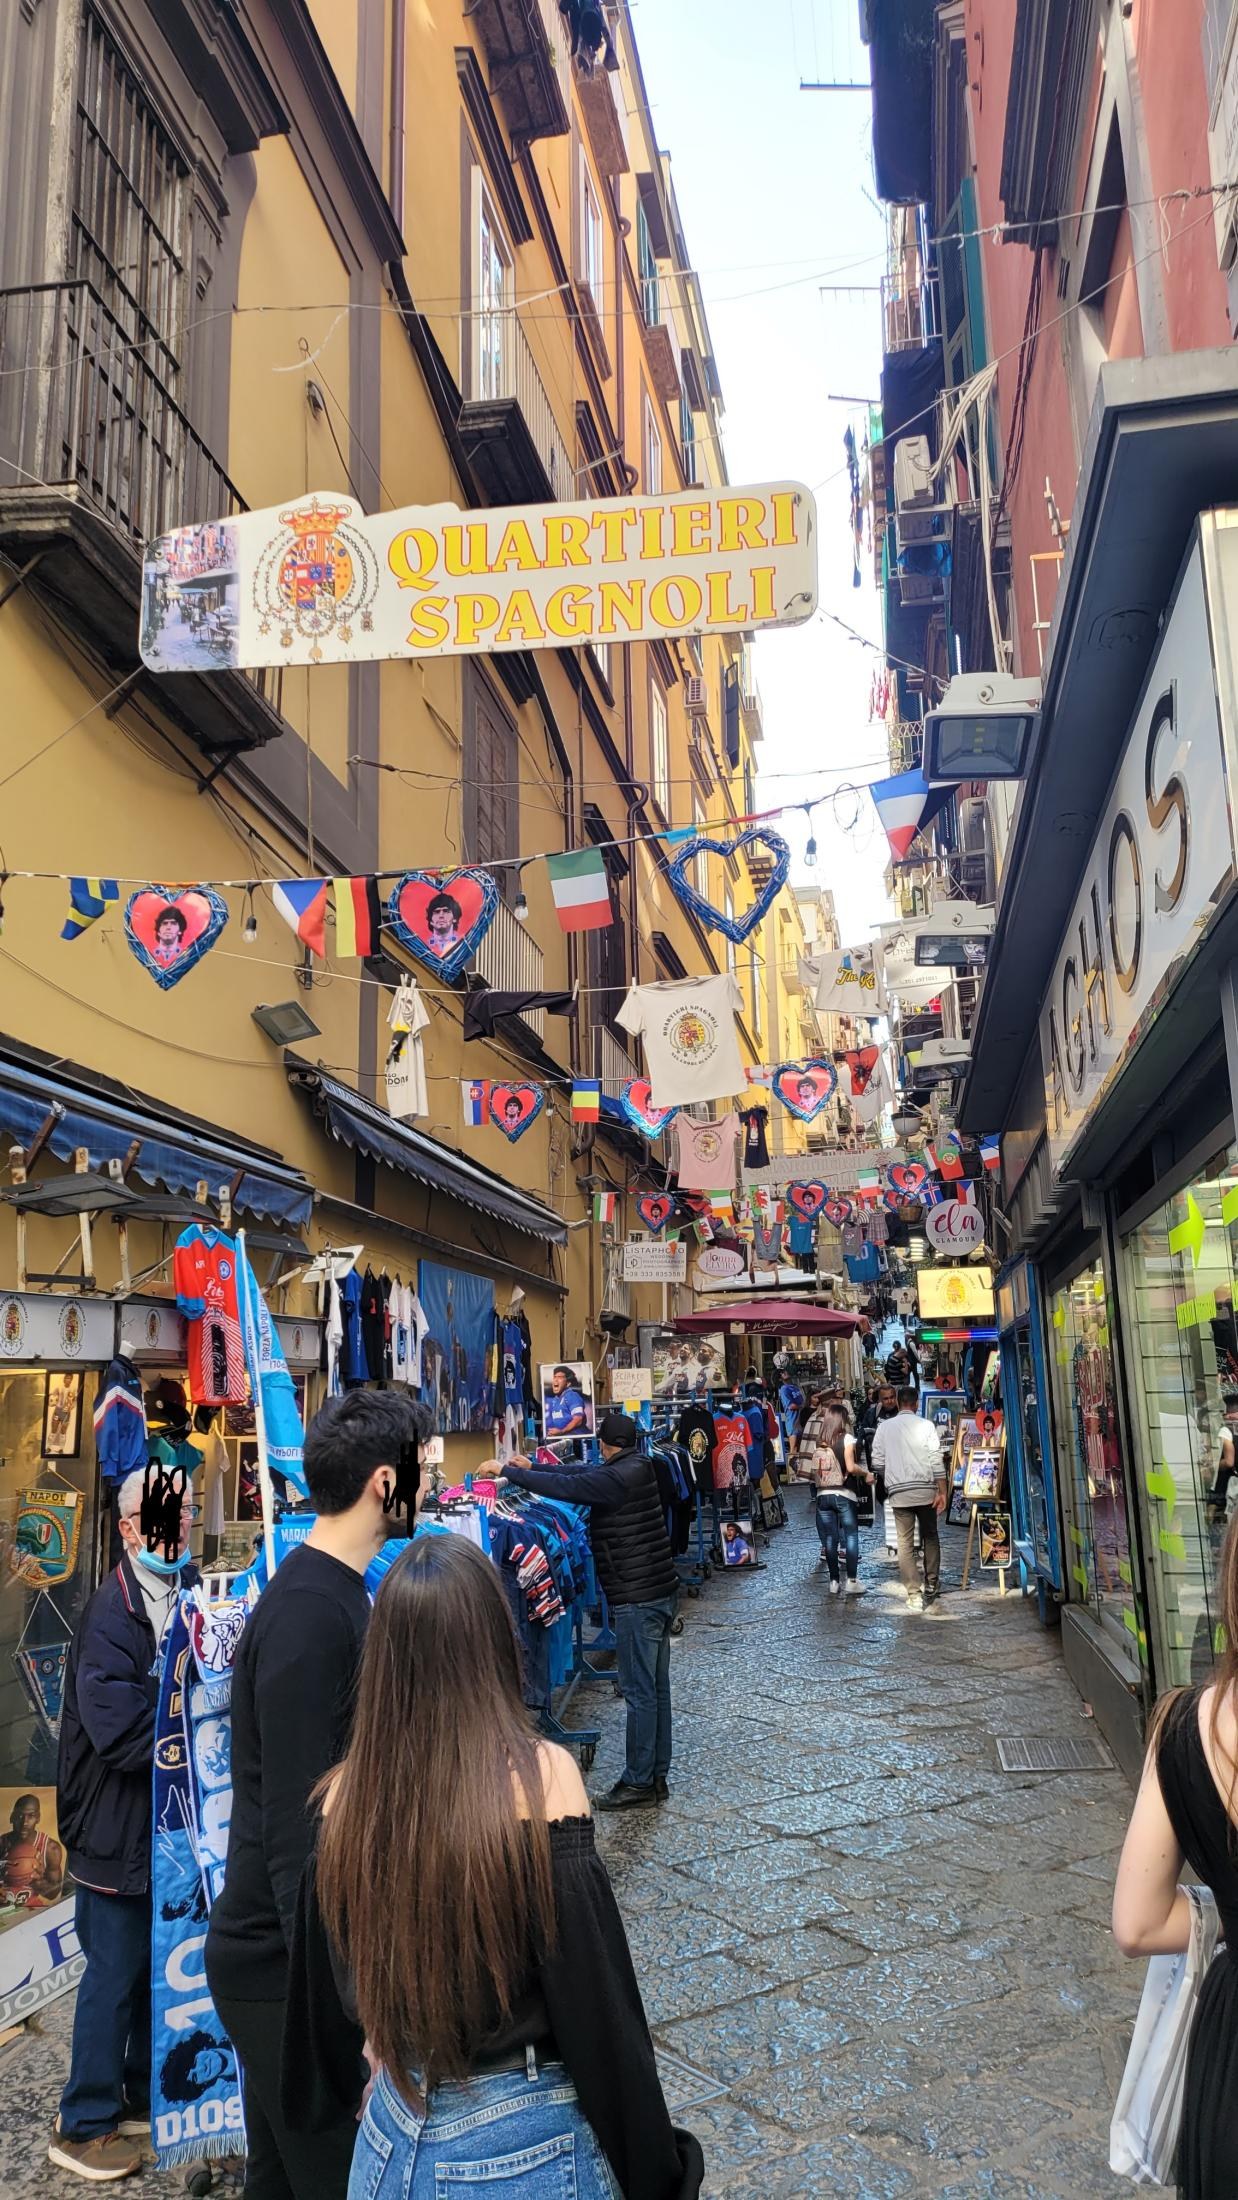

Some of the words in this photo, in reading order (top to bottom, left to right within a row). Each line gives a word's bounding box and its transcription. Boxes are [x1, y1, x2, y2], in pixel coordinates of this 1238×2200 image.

[387, 492, 800, 591] QUARTIERI
[406, 566, 778, 649] SPAGNOLI
[690, 1005, 719, 1028] SPAGNOLI
[929, 1203, 979, 1237] ela
[935, 1236, 976, 1244] GLAMOUR
[260, 1309, 271, 1336] NAPOLI
[261, 1337, 272, 1362] FORZA
[30, 1491, 66, 1502] NAPOL
